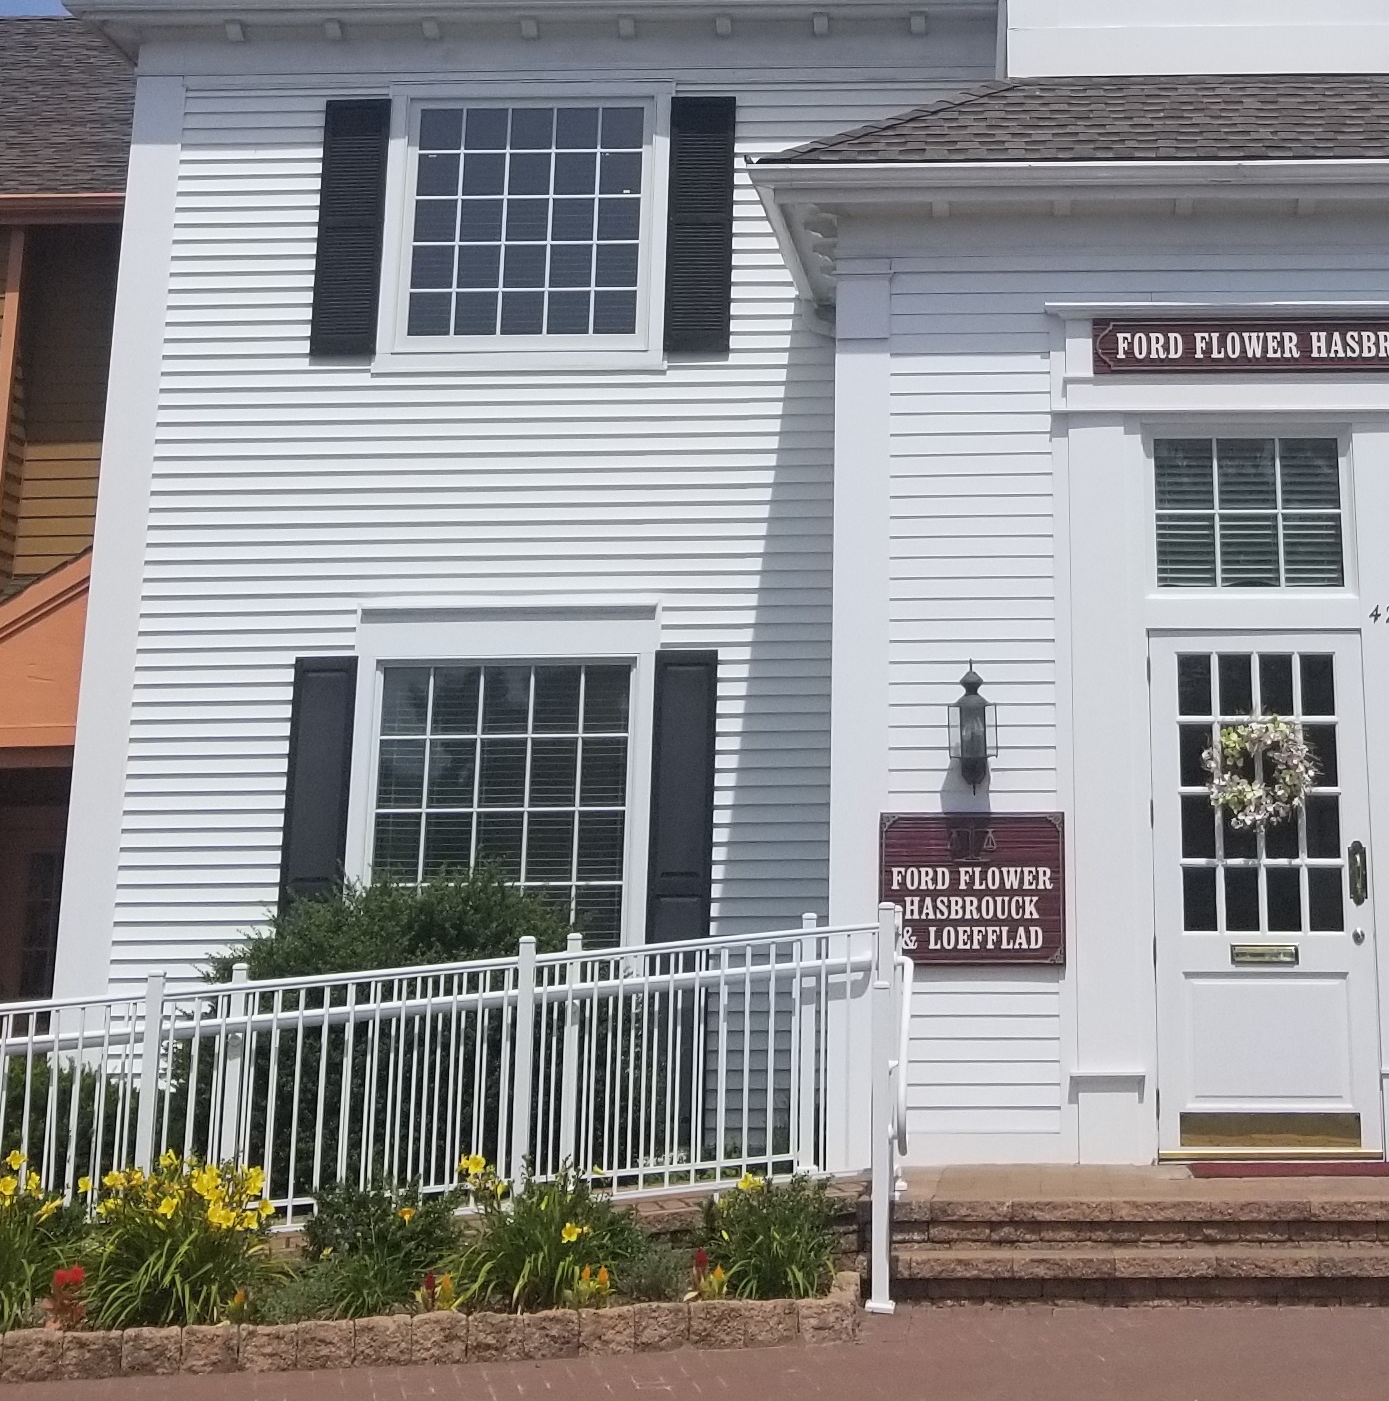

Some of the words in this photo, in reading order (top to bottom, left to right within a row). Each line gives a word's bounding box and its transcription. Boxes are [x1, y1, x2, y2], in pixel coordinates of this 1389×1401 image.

[1116, 332, 1183, 359] FORD
[1194, 332, 1300, 359] FLOWER
[891, 867, 950, 890] FORD
[959, 867, 1054, 890] FLOWER
[904, 896, 1040, 919] HASBROUCK
[902, 926, 918, 949] &
[928, 926, 1043, 949] LOEFFLAD
